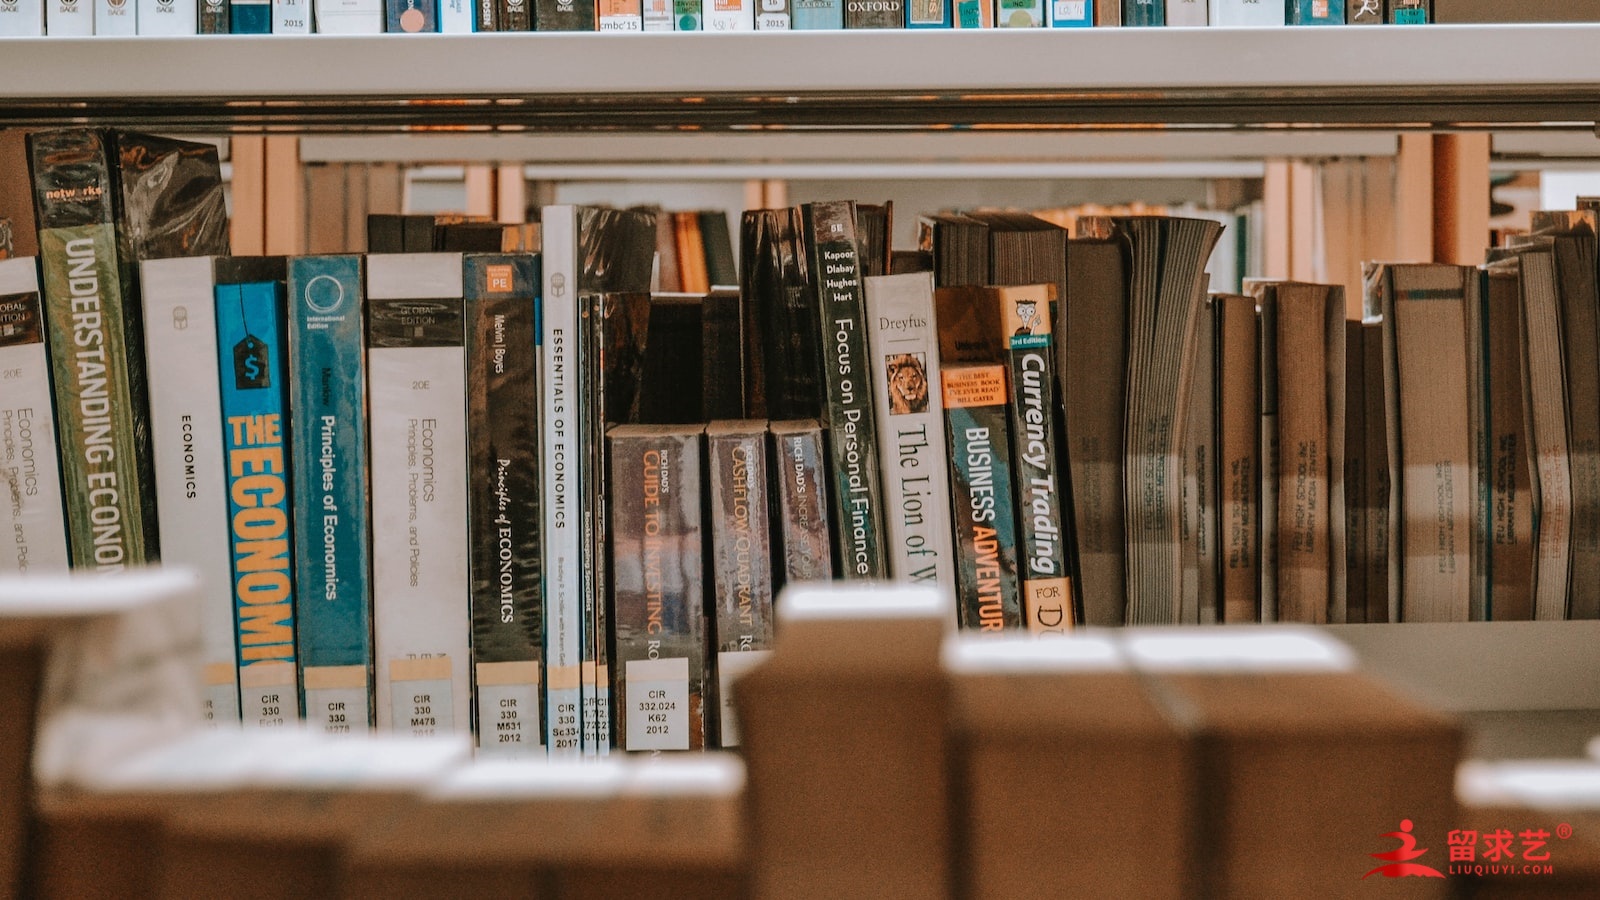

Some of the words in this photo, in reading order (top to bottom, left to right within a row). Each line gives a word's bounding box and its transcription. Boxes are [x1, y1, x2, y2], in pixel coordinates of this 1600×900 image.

[848, 2, 900, 12] OXFORD
[284, 19, 304, 27] 2015
[46, 185, 103, 199] netwrks
[824, 251, 855, 262] Kapoor
[826, 265, 855, 275] Dlabay
[492, 279, 507, 288] PE
[826, 279, 857, 289] Hughes
[833, 293, 853, 302] Hart
[306, 315, 346, 323] International
[401, 306, 434, 315] GLOBAL
[401, 316, 435, 325] EDITION
[494, 314, 506, 343] Melvin
[879, 314, 927, 333] Dreyfus
[65, 238, 115, 465] UNDERSTANDING
[835, 318, 854, 376] Focus
[1012, 338, 1022, 346] 3rd
[1023, 336, 1048, 345] Edition
[494, 348, 506, 374] Boyes
[553, 328, 564, 414] ESSENTIALS
[3, 368, 23, 379] 20E
[980, 378, 1000, 387] BOOK
[412, 380, 430, 390] 20E
[840, 382, 854, 405] on
[1021, 353, 1047, 470] Currency
[228, 413, 282, 446] THE
[554, 419, 565, 438] OF
[17, 407, 39, 497] Economics
[319, 415, 337, 492] Principles
[406, 418, 418, 470] Principles,
[793, 436, 803, 462] RICH
[843, 409, 869, 494] Personal
[897, 423, 929, 469] The
[181, 415, 197, 500] ECONOMICS
[421, 418, 437, 503] Economics
[660, 449, 669, 470] RICH
[495, 458, 511, 511] Principles
[554, 443, 566, 529] ECONOMICS
[643, 450, 661, 508] GUIDE
[661, 470, 670, 494] DAD'S
[795, 464, 806, 494] DAD'S
[964, 427, 996, 523] BUSINESS
[407, 472, 419, 524] Problems,
[731, 446, 750, 536] CASHFLOW
[900, 474, 931, 527] Lion
[322, 494, 339, 511] of
[495, 513, 511, 524] of
[644, 509, 661, 536] TO
[797, 494, 810, 547] INCREASE
[1031, 474, 1059, 574] Trading
[14, 522, 26, 544] and
[408, 525, 419, 547] and
[584, 511, 592, 569] Bookkeeping
[850, 497, 870, 575] Finance
[230, 447, 295, 665] ECONOMI
[905, 534, 938, 557] of
[323, 514, 339, 601] Economics
[409, 548, 420, 588] Policies
[499, 526, 514, 624] ECONOMICS
[736, 537, 753, 626] QUADRANT
[973, 525, 1004, 633] ADVENTUR
[645, 540, 663, 635] INVESTING
[1035, 586, 1061, 599] FOR
[261, 694, 280, 704] CIR
[413, 695, 431, 703] CIR
[500, 698, 517, 707] CIR
[648, 690, 666, 699] CIR
[262, 706, 280, 715] 330
[328, 702, 345, 711] CIR
[414, 706, 431, 714] 330
[500, 710, 517, 719] 330
[558, 704, 575, 713] CIR
[639, 702, 676, 711] 332.024
[329, 714, 346, 723] 330
[411, 717, 436, 726] M478
[496, 722, 522, 731] M531
[558, 715, 575, 724] 330
[648, 714, 667, 722] K62
[498, 733, 521, 742] 2012
[646, 725, 669, 734] 2012
[556, 739, 578, 748] 2017
